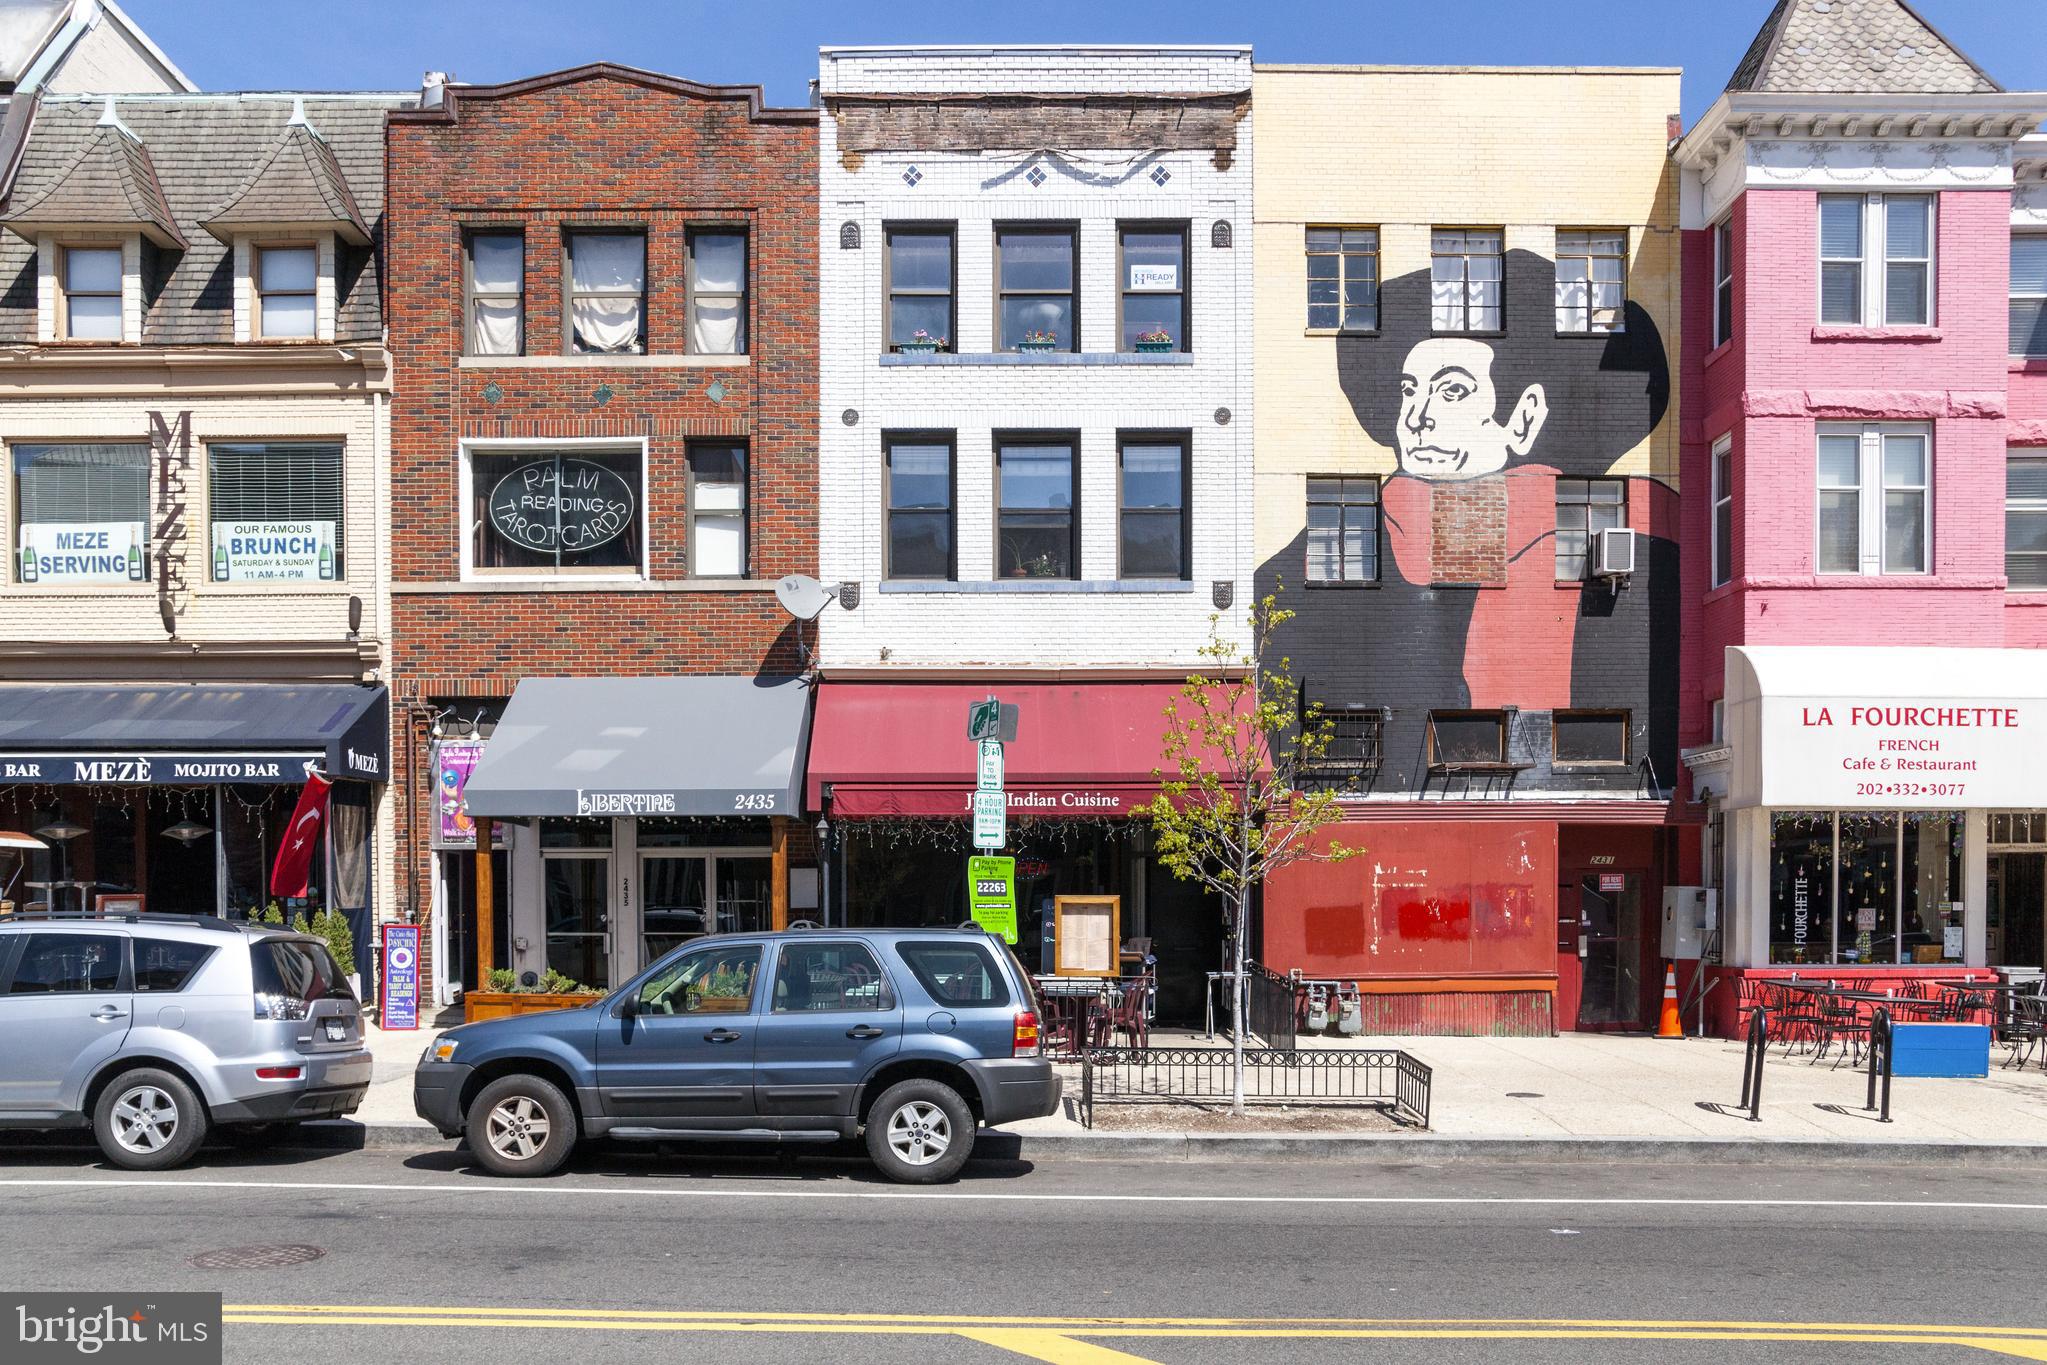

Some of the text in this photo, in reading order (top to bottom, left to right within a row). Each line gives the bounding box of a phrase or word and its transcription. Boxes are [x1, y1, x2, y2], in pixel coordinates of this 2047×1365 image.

[523, 466, 599, 492] PALM
[496, 498, 627, 546] TAROT CARDS
[234, 525, 312, 534] OUR FAMOUS
[56, 532, 109, 549] MEZE
[231, 537, 316, 555] BRUNCH
[40, 555, 126, 574] SERVING
[232, 559, 273, 567] SATURDAY
[288, 570, 304, 578] PM
[1802, 707, 2019, 727] LA FOURCHETTE
[1878, 740, 1940, 751] FRENCH
[5, 764, 42, 777] BAR
[174, 763, 241, 777] MOJITO
[244, 763, 280, 777] BAR
[1842, 757, 1977, 771] Cafe & Restaurant
[734, 794, 775, 810] 2435
[978, 798, 982, 806] 4
[985, 798, 1003, 807] HOUR
[1007, 792, 1120, 807] Indian Cuisine
[977, 808, 1002, 816] PARKING
[977, 882, 1006, 893] 22263
[1794, 878, 1808, 945] FOURCHETTE
